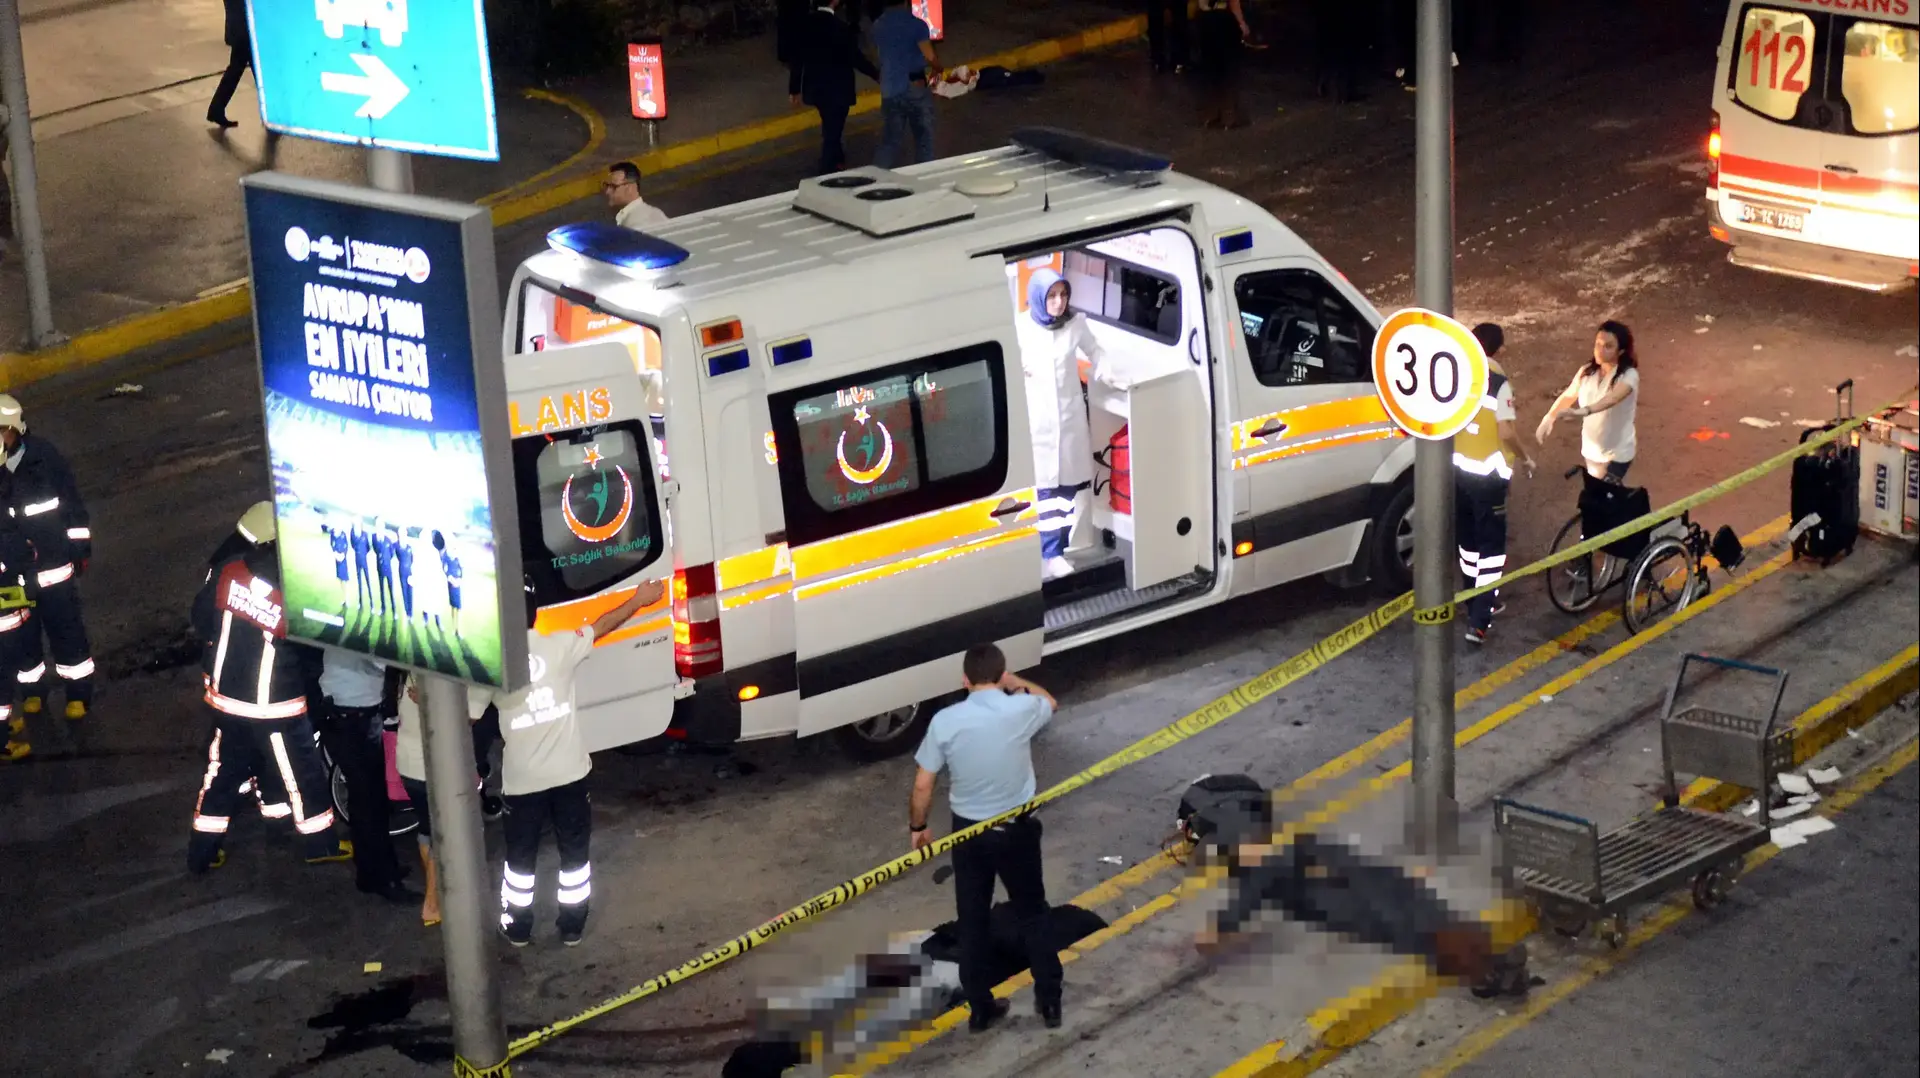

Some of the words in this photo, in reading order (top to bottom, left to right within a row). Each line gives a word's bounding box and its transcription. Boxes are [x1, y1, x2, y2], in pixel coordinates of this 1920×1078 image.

[1744, 29, 1806, 93] 112
[304, 321, 340, 370] EN
[1395, 343, 1459, 403] 30
[570, 549, 602, 565] Sağlık
[605, 535, 651, 556] Bakanlığı
